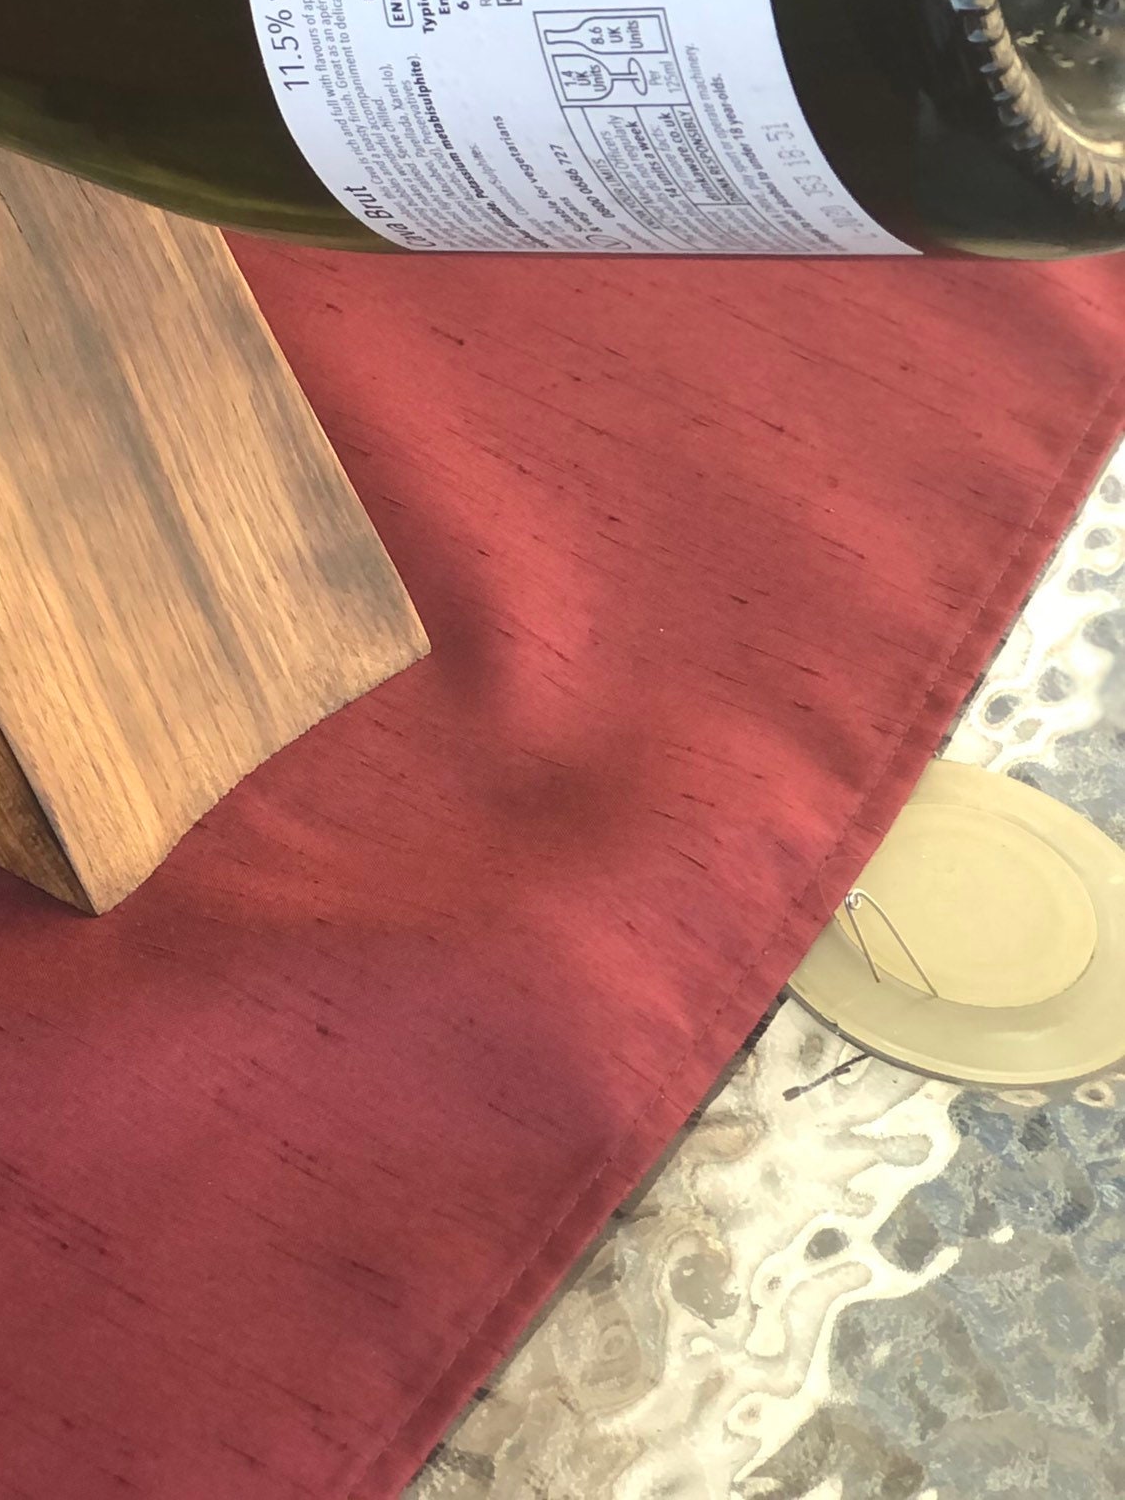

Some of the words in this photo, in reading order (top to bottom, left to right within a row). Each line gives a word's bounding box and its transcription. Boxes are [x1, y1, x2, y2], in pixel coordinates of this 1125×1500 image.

[457, 1, 469, 10] 6
[301, 14, 316, 25] of
[324, 28, 335, 42] an
[339, 32, 350, 44] to
[589, 26, 605, 45] 8.6
[607, 27, 623, 43] UK
[627, 20, 644, 49] Units
[266, 10, 308, 90] 11.5%
[309, 28, 327, 71] flavours
[328, 45, 339, 57] as
[319, 75, 335, 97] with
[331, 60, 348, 89] Great
[561, 70, 577, 87] 1.4
[575, 71, 591, 86] UK
[589, 64, 609, 92] Units
[644, 70, 662, 86] Per
[659, 61, 682, 93] 125ml
[685, 46, 710, 100] machinery.
[342, 47, 380, 130] accompaniment
[379, 64, 404, 110] Xarel-lo),
[711, 75, 742, 125] year-olds.
[326, 100, 343, 116] full
[341, 91, 360, 122] finish.
[371, 97, 396, 132] chilled.
[402, 80, 435, 145] Preservatives
[409, 54, 453, 149] metabisulphite).
[334, 119, 353, 137] and
[703, 103, 730, 139] operate
[729, 127, 745, 140] 18
[346, 139, 363, 155] rich
[356, 125, 377, 152] toasty
[390, 134, 411, 159] Serve
[398, 113, 427, 158] Parellada,
[608, 115, 639, 161] regularly
[626, 121, 649, 151] week
[679, 111, 721, 175] RESPONSIBLY
[720, 141, 733, 150] or
[358, 157, 370, 165] is
[371, 133, 407, 176] wonderful
[494, 116, 537, 183] vegetarians
[549, 144, 571, 165] 727
[595, 131, 629, 169] Officers
[659, 113, 721, 201] drinkaware.co.uk
[740, 143, 763, 170] under
[365, 166, 384, 185] Cava
[372, 160, 393, 176] and
[449, 153, 488, 198] Potassium
[565, 168, 593, 194] 0686
[593, 159, 621, 186] LIMITS
[633, 163, 651, 179] not
[649, 161, 673, 186] units
[757, 171, 770, 180] to
[534, 185, 551, 199] for
[621, 171, 654, 204] Medical
[646, 180, 662, 192] do
[664, 188, 681, 198] 14
[344, 186, 393, 219] Brut
[560, 197, 593, 225] vegans
[586, 196, 615, 218] 0800
[548, 201, 587, 232] Suitable
[386, 223, 436, 247] Cava
